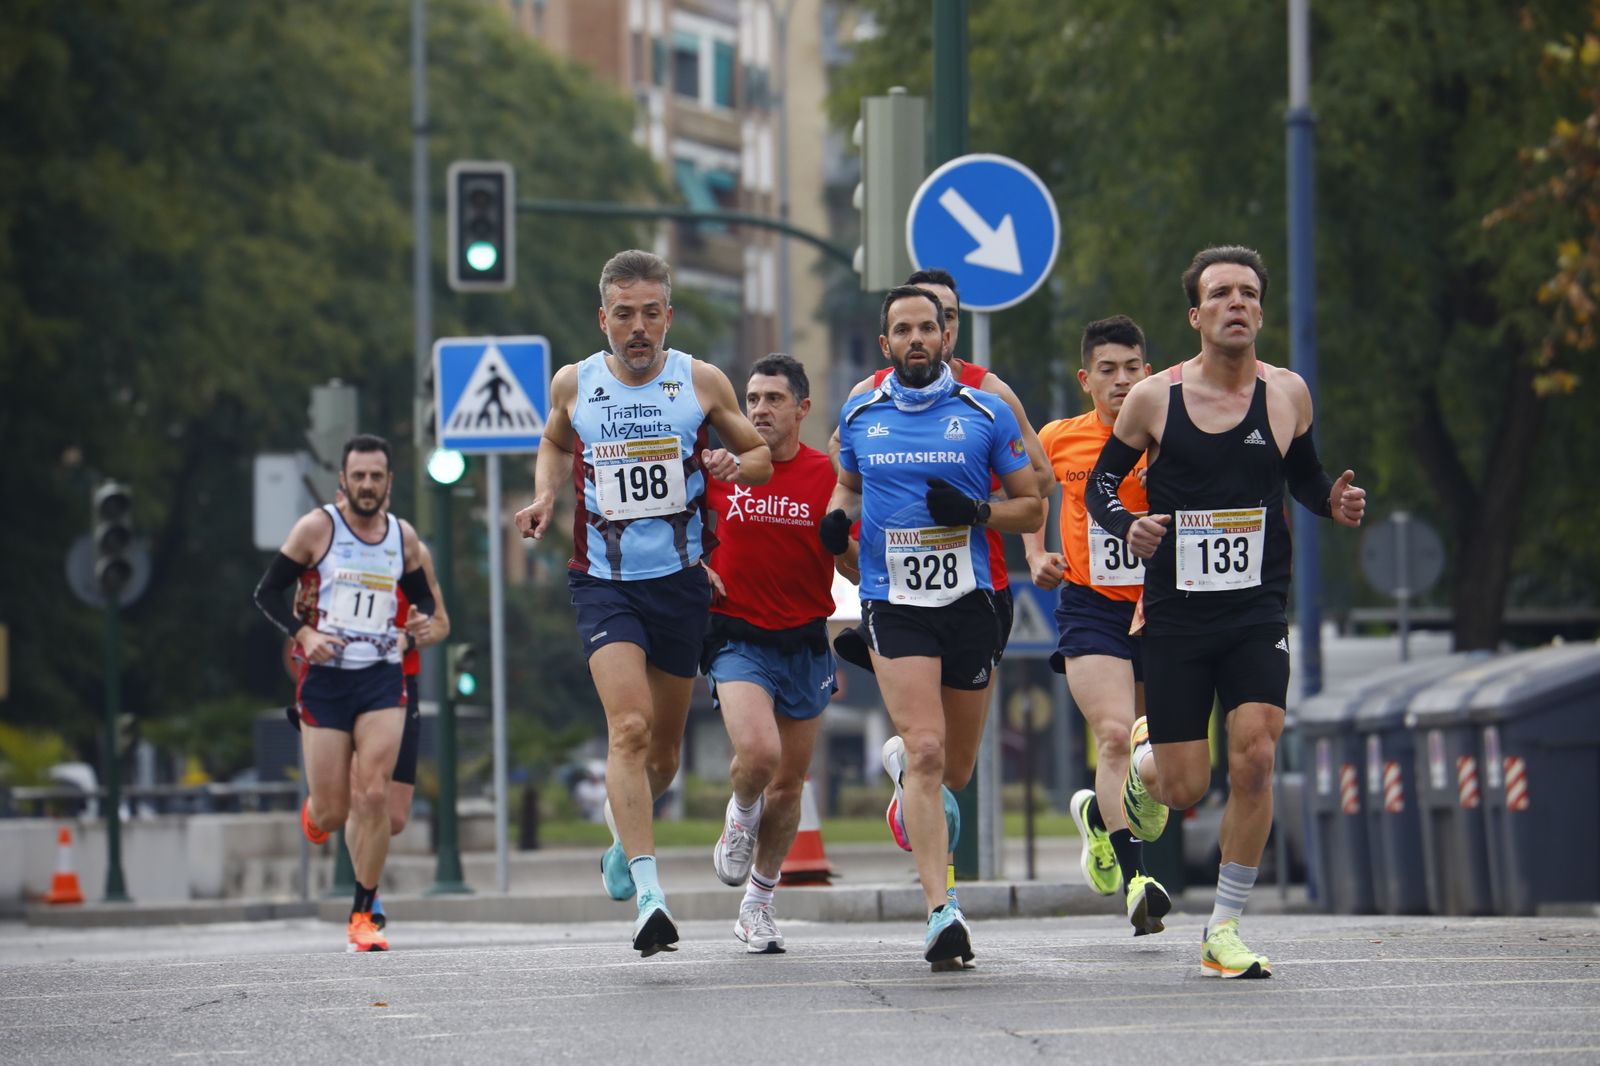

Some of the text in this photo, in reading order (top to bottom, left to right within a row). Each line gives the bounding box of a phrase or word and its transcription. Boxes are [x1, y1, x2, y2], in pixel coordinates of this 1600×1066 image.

[595, 444, 627, 459] XXXIX
[867, 451, 966, 465] TROTASIERRA
[614, 464, 668, 502] 198
[1180, 514, 1212, 527] XXXIX
[888, 532, 920, 545] XXXIX
[1197, 536, 1249, 575] 133
[903, 552, 958, 590] 328
[354, 591, 375, 618] 11
